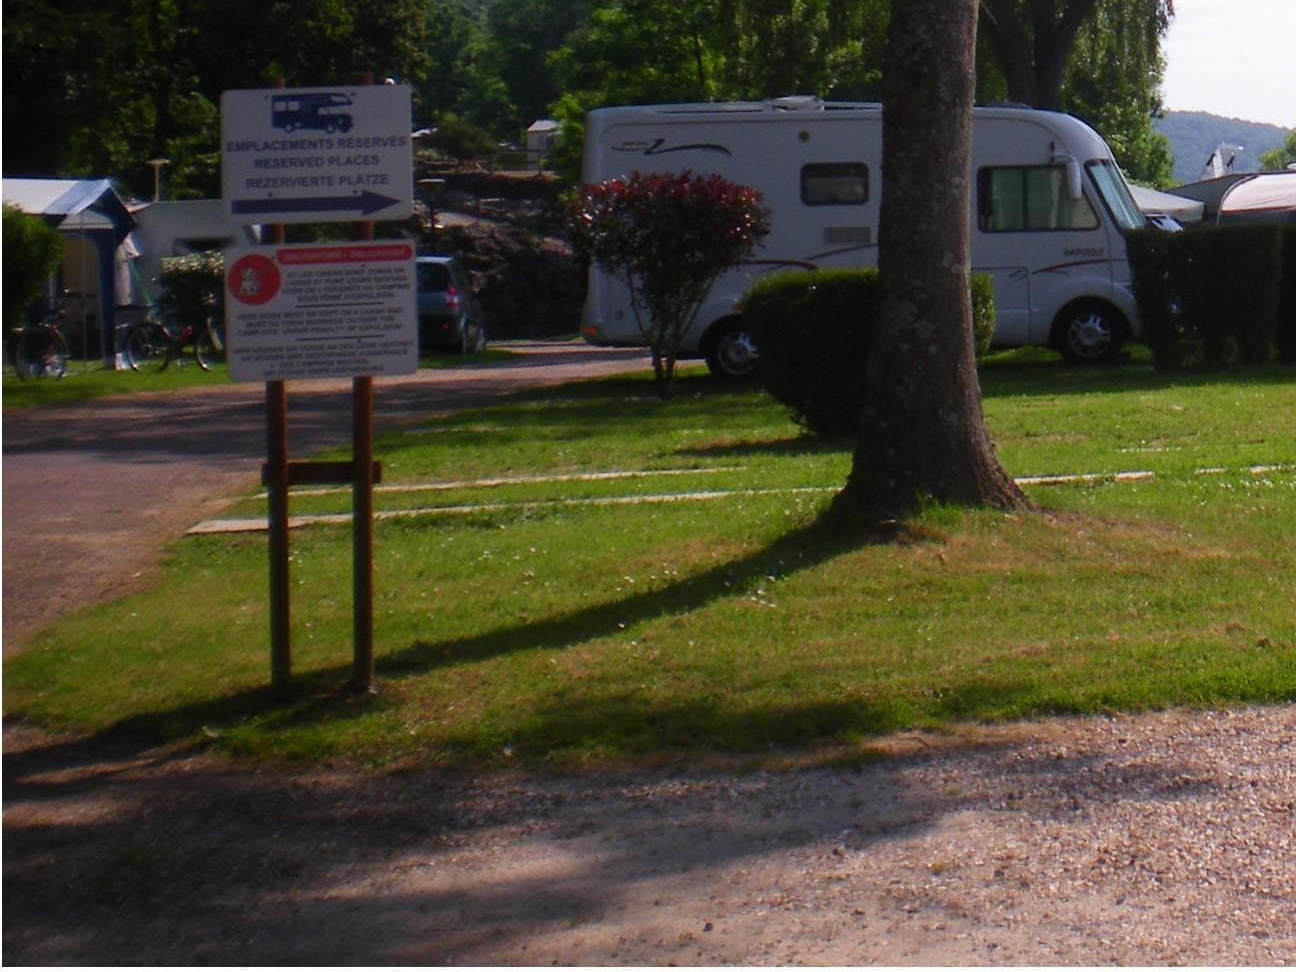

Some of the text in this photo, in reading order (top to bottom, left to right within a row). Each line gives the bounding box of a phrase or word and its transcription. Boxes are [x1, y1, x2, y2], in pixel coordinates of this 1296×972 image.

[226, 139, 334, 152] EMPLACEMENTS
[254, 155, 380, 169] RESERVED PLACES
[245, 176, 336, 189] REZERVIERTE
